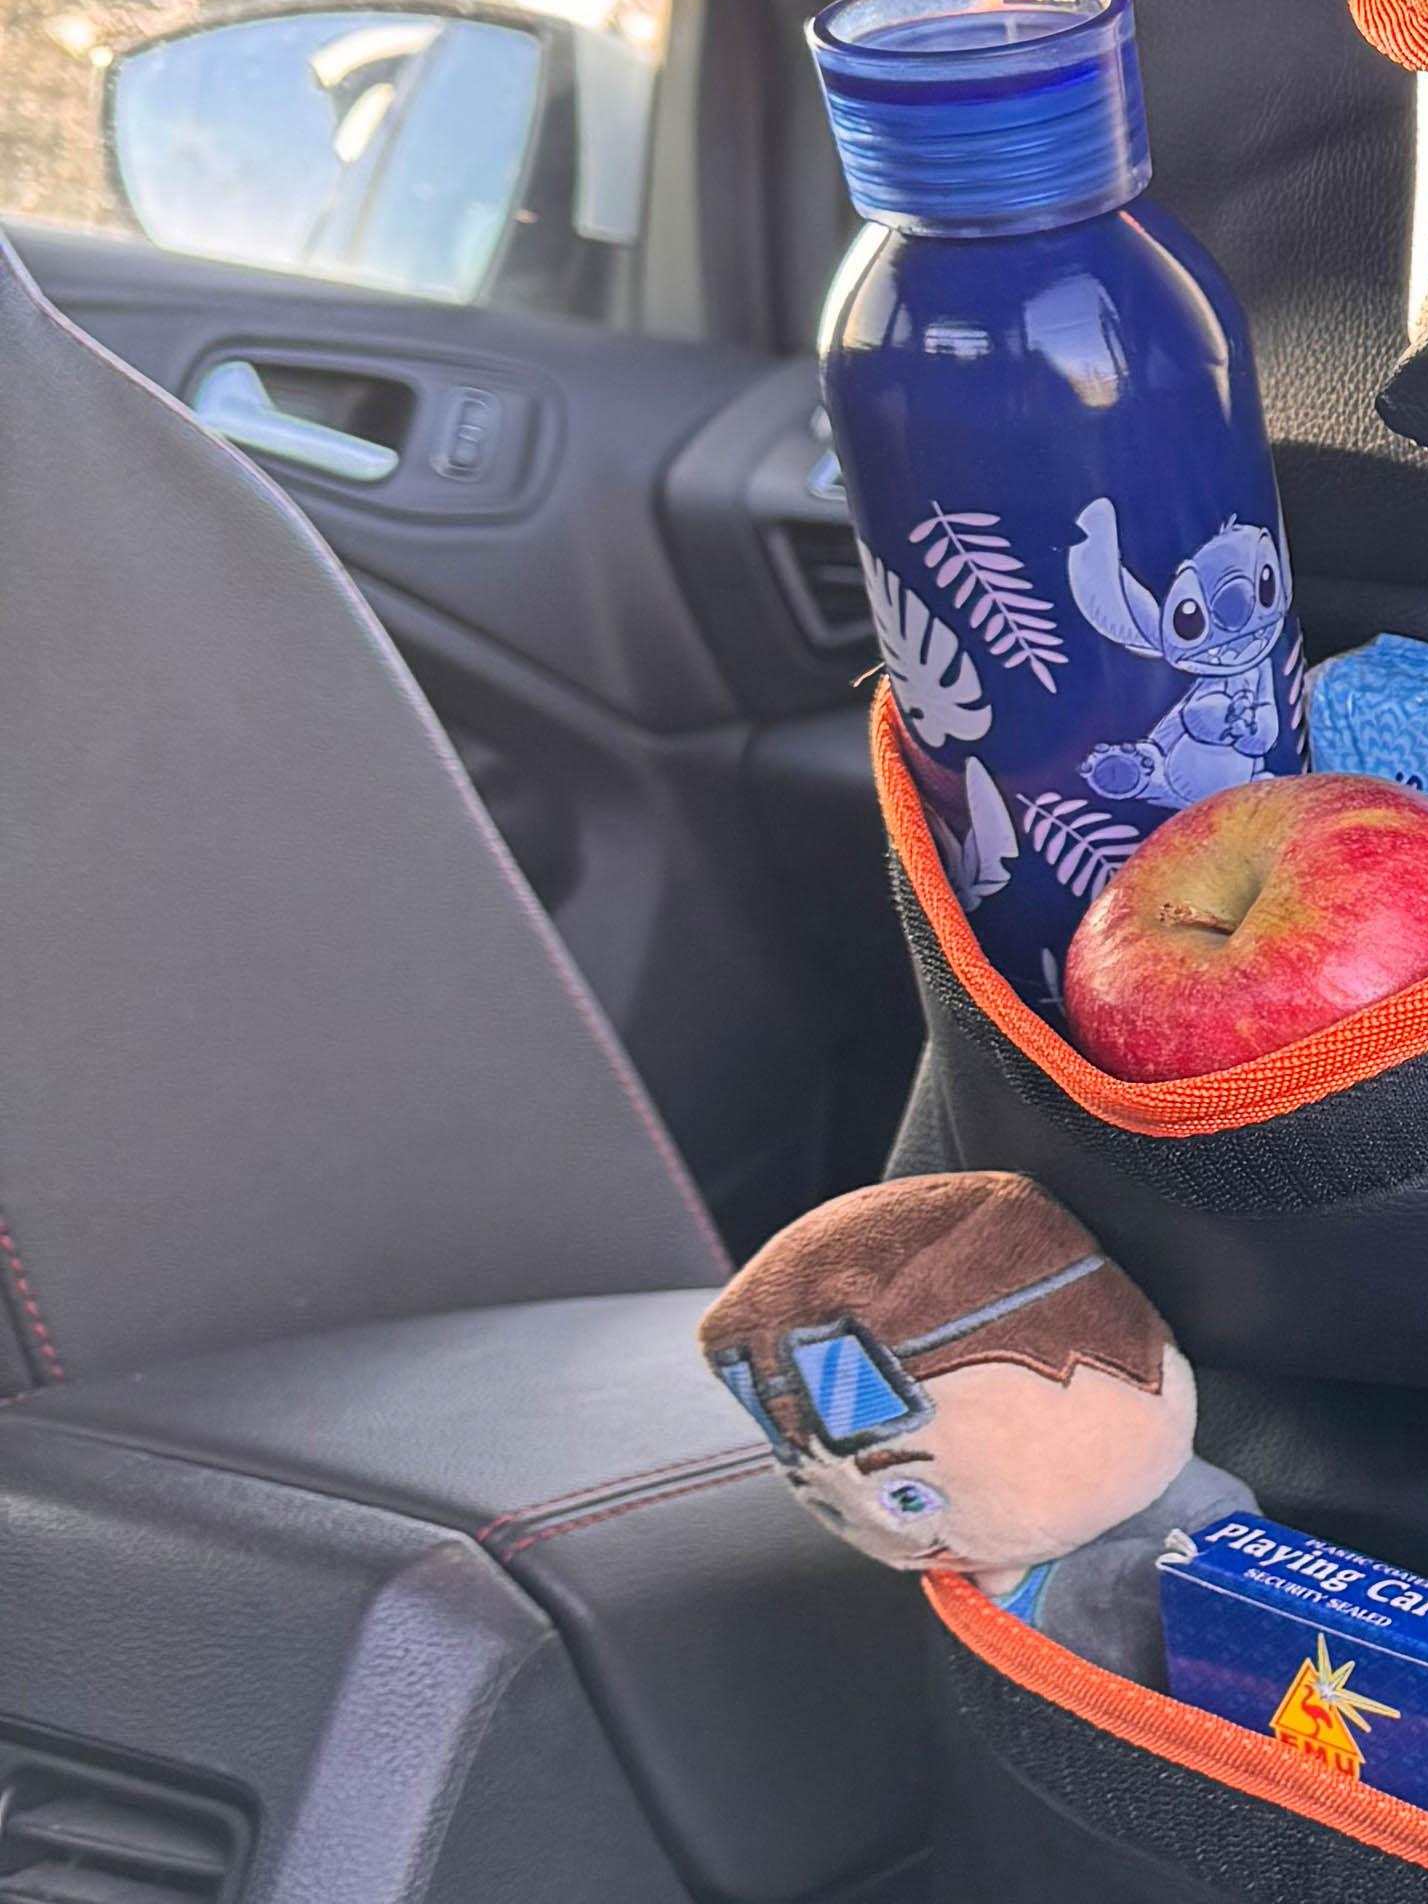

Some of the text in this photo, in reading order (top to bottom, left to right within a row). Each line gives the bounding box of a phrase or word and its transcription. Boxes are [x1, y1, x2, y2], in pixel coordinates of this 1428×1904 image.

[1205, 1522, 1365, 1593] Playing
[1306, 1538, 1371, 1569] PLASTIC
[1243, 1567, 1393, 1628] SECURITY SEALED
[1280, 1732, 1355, 1778] EMU
